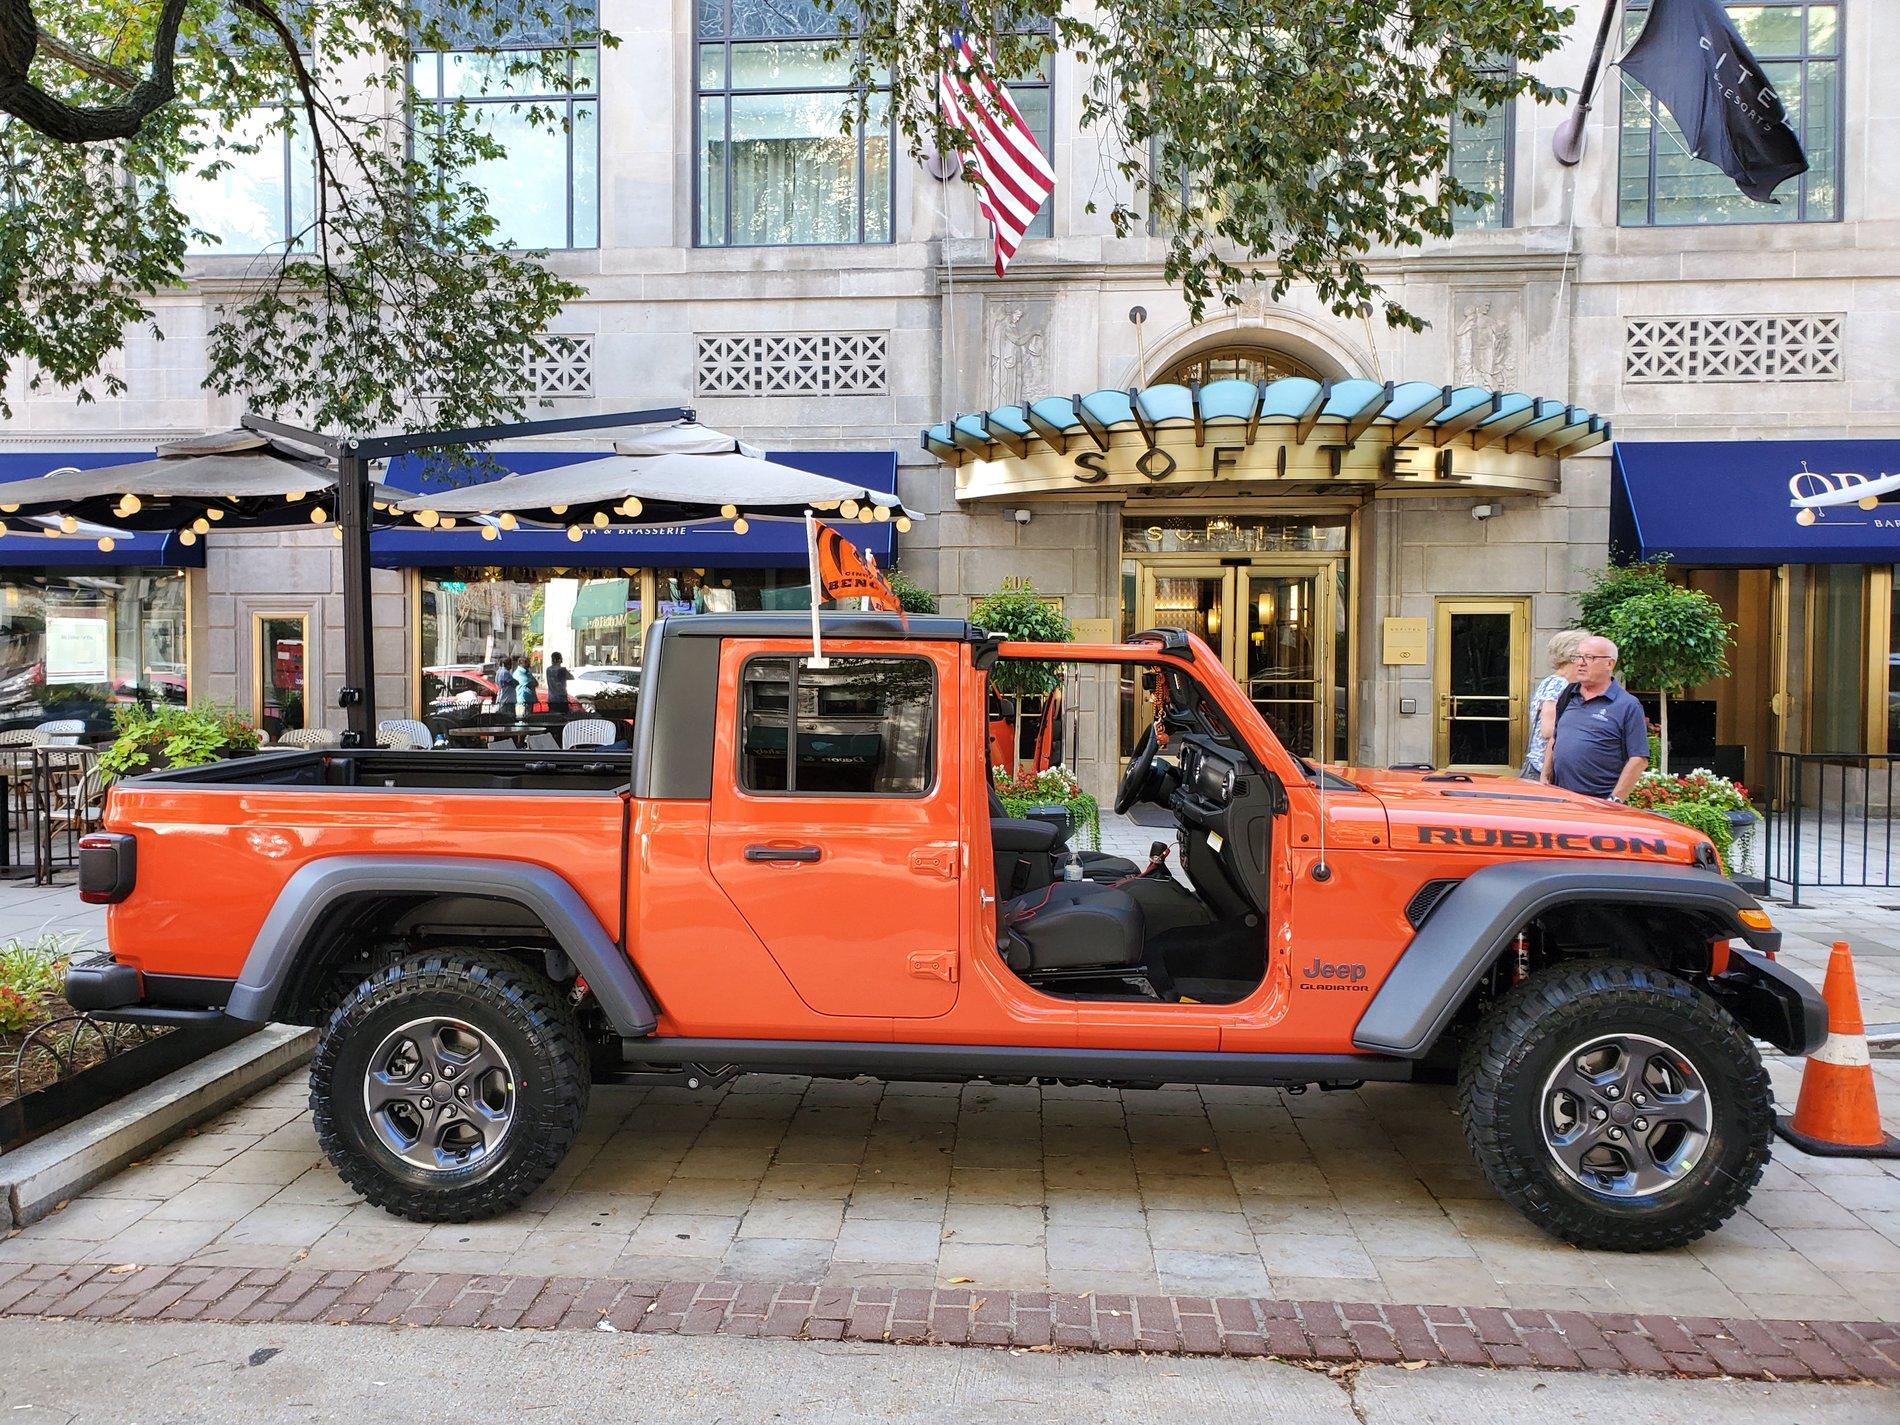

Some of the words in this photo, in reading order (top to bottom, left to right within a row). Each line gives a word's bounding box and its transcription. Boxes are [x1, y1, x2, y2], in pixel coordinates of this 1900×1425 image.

[1074, 445, 1472, 483] SOFITEL
[618, 527, 687, 535] BRASSERIE
[1417, 826, 1667, 855] RUBICON
[1303, 957, 1366, 983] Jeep
[1300, 983, 1369, 992] GLADIATOR
